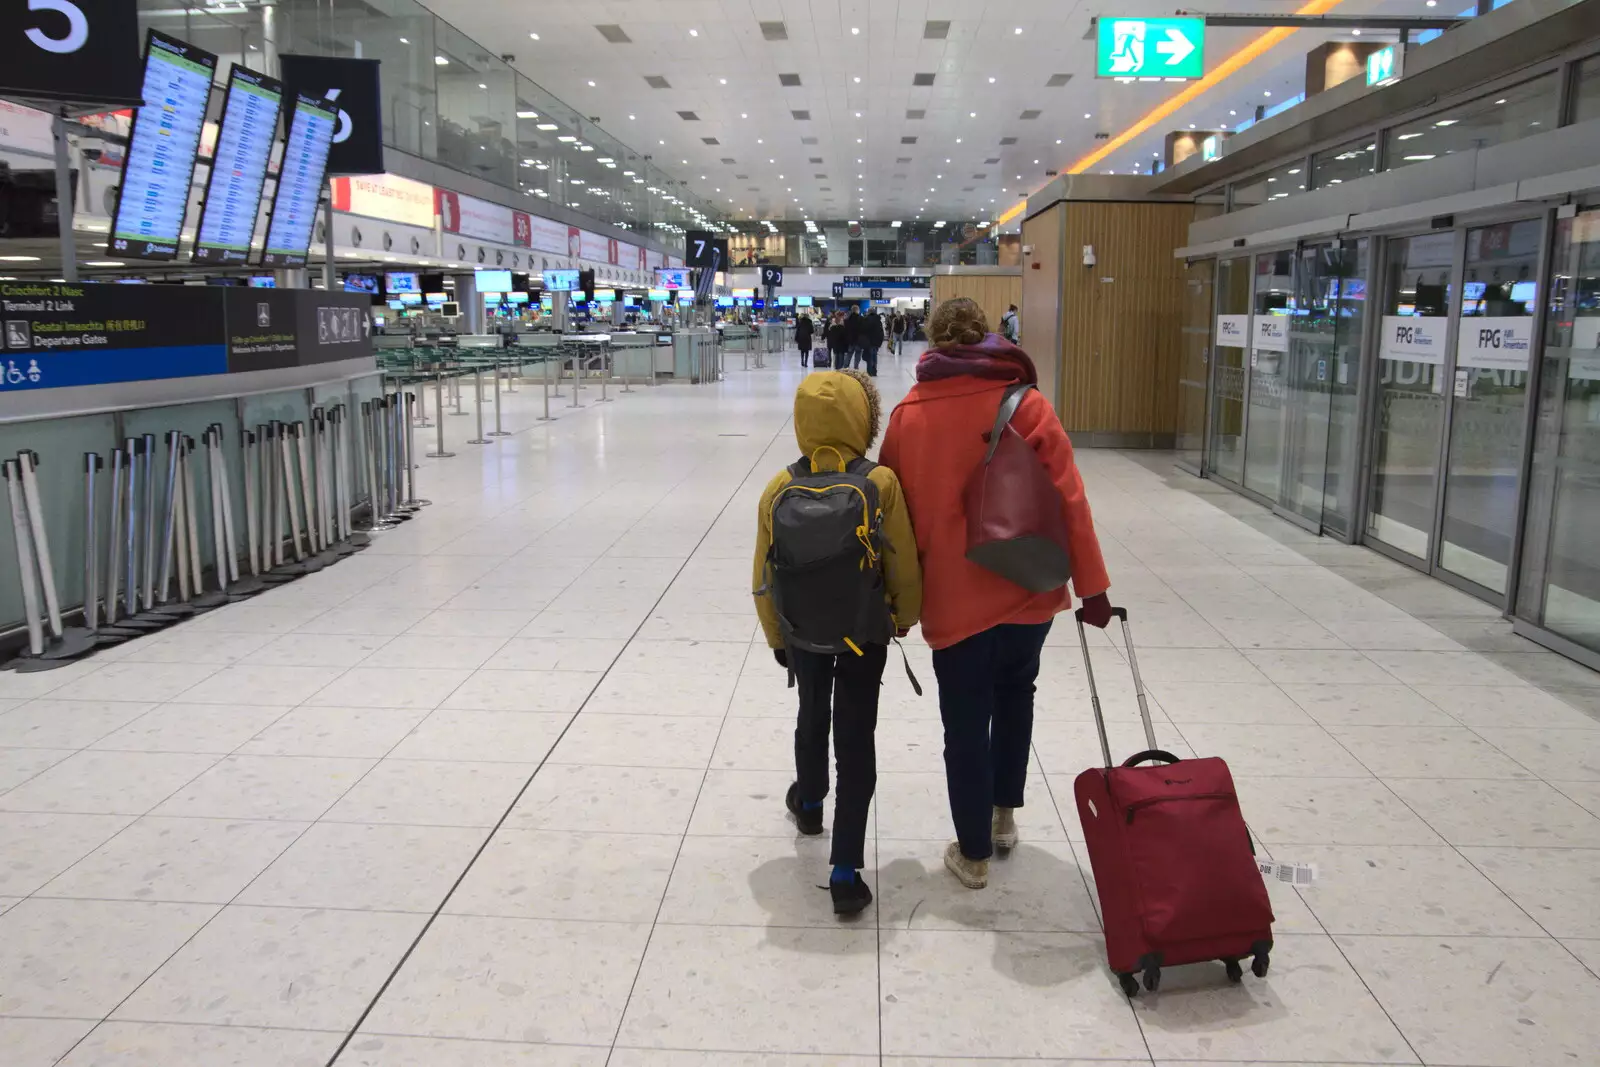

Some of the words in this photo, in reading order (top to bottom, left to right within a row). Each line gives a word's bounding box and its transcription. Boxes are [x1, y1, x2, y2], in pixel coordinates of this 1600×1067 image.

[24, 0, 89, 54] 5
[694, 240, 705, 258] 7
[766, 270, 774, 280] 9
[54, 285, 60, 296] 2
[834, 286, 842, 294] 11
[2, 300, 45, 311] Terminal
[46, 301, 53, 311] 2
[55, 300, 75, 311] Link
[33, 335, 81, 348] Departure
[82, 334, 108, 345] Gates
[1396, 326, 1413, 344] FPG
[1479, 328, 1501, 348] FPG
